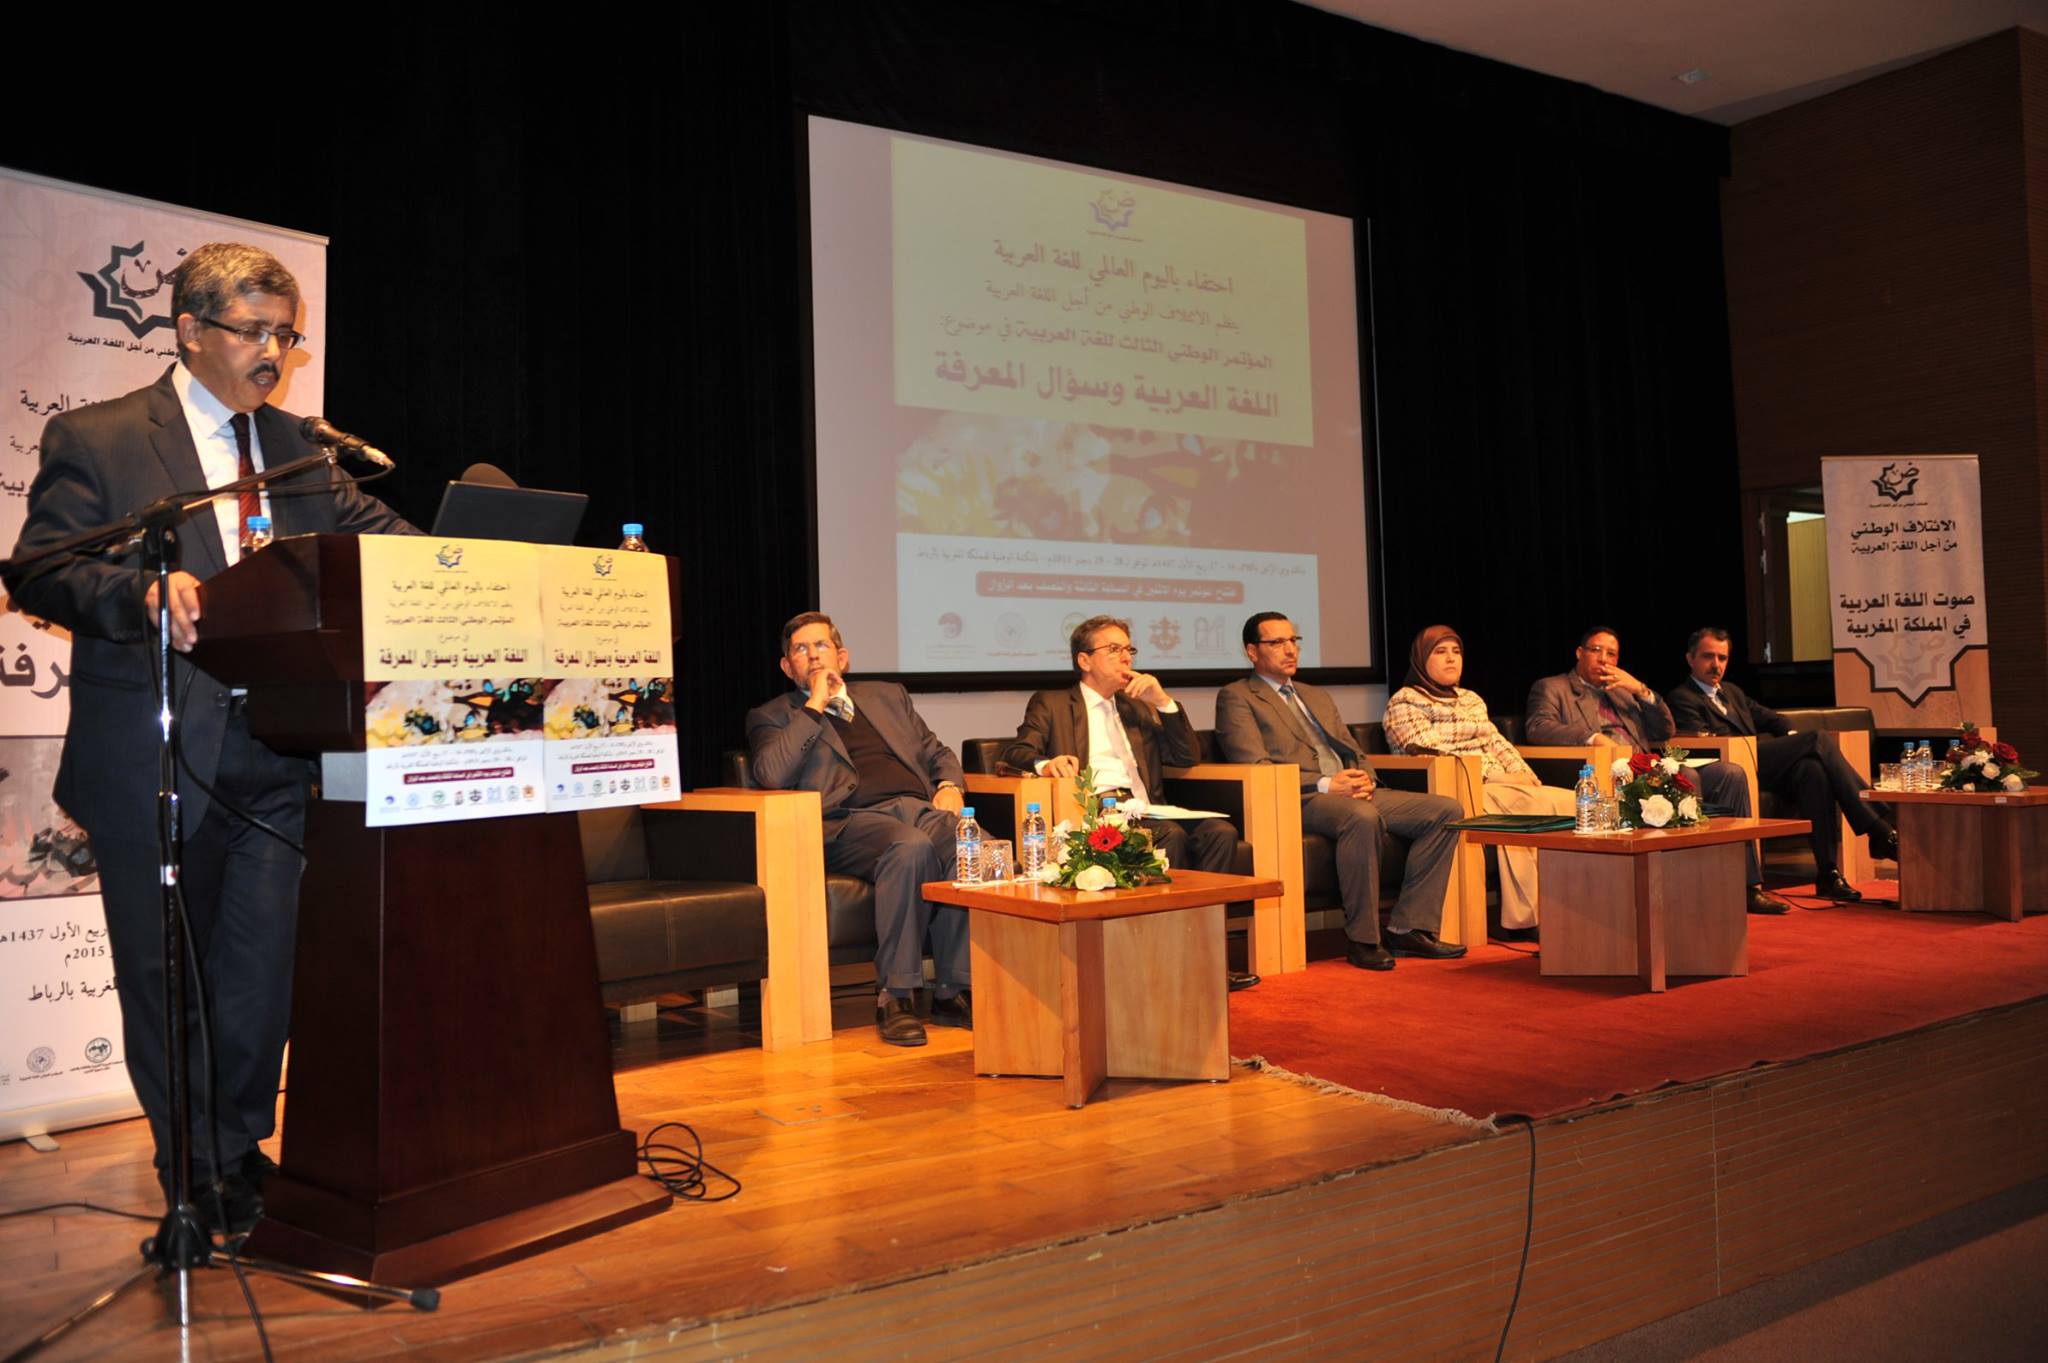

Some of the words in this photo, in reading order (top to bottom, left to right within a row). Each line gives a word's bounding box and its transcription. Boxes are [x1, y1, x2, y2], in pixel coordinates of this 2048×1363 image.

[993, 239, 1046, 268] العربية
[1051, 248, 1081, 270] للغة
[1089, 254, 1135, 287] العالمي
[1142, 264, 1180, 294] باليوم
[985, 280, 1025, 301] العربية
[1186, 270, 1234, 294] احتفاء
[1030, 285, 1056, 303] اللغة
[1062, 284, 1089, 312] أجل
[1094, 302, 1113, 316] من
[1119, 300, 1153, 321] الوطني
[67, 332, 100, 345] العربية
[999, 317, 1012, 342] في
[1016, 320, 1077, 343] العربية
[1080, 327, 1114, 348] للغة
[102, 337, 125, 348] اللغة
[126, 342, 142, 352] أجل
[1119, 335, 1164, 354] الثالث
[1168, 342, 1219, 363] الوطني
[156, 348, 181, 359] وطني
[1222, 352, 1273, 371] المؤتمر
[934, 350, 1025, 391] المعرفة
[1036, 366, 1125, 405] وسؤال
[1134, 374, 1218, 414] العربية
[20, 389, 70, 416] العربية
[1226, 384, 1280, 417] اللغة
[1851, 521, 1899, 540] الوطني
[1902, 519, 1957, 534] الائتلاف
[1851, 542, 1890, 554] العربية
[1892, 540, 1918, 552] اللغة
[1920, 538, 1941, 552] أجل
[1943, 541, 1958, 552] من
[1840, 593, 1890, 613] العربية
[1894, 592, 1928, 607] اللغة
[1933, 592, 1975, 609] صوت
[1847, 617, 1899, 638] المغربية
[1904, 616, 1948, 632] المملكة
[1953, 614, 1971, 639] في
[379, 648, 417, 669] المعرفة
[420, 648, 460, 669] وسؤال
[463, 648, 501, 669] العربية
[503, 647, 529, 664] اللغة
[50, 920, 81, 941] الأول
[85, 927, 108, 944] ربيع
[64, 945, 105, 968] 2015م
[28, 980, 74, 1003] بالرباط
